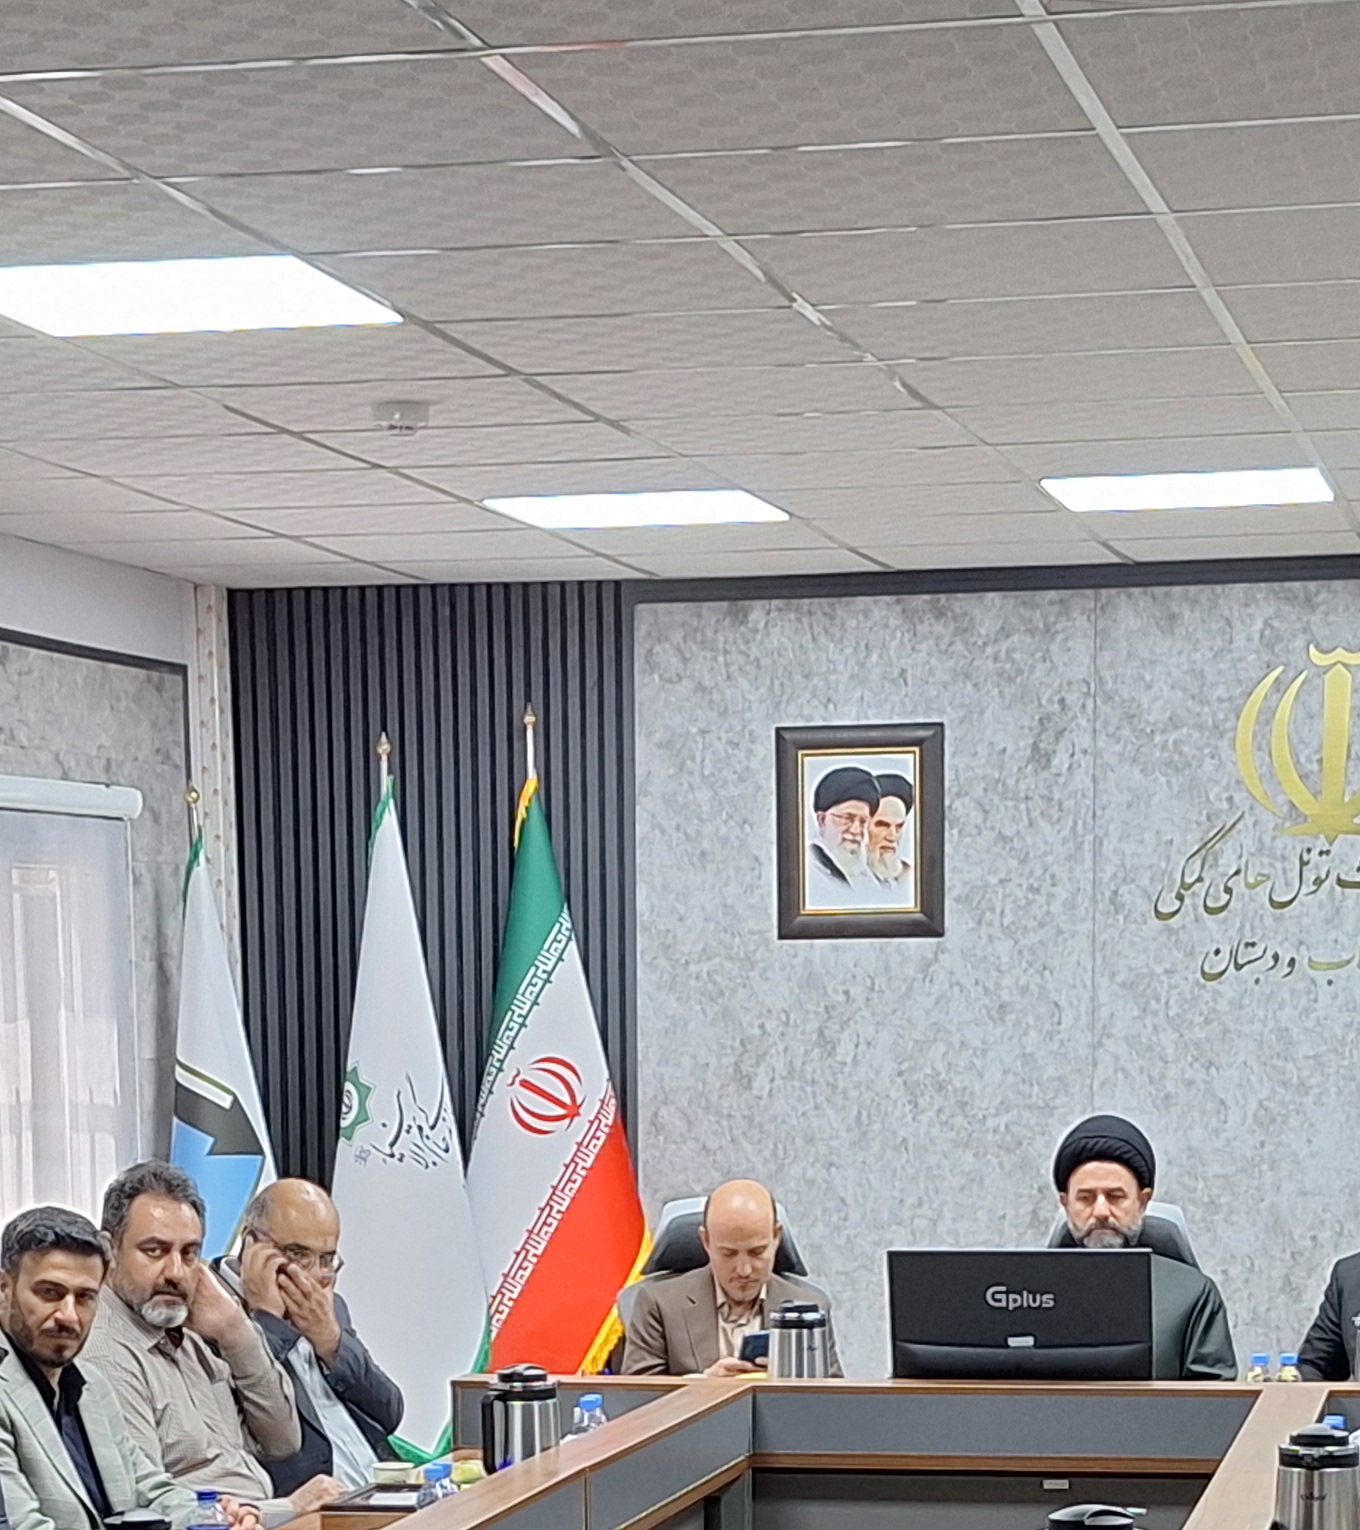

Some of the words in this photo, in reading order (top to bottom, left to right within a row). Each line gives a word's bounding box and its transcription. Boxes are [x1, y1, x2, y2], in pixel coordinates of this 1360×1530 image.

[1269, 845, 1331, 909] تونل
[1200, 938, 1281, 986] دبستان
[1282, 954, 1297, 978] و
[986, 1286, 1055, 1310] Gplus
